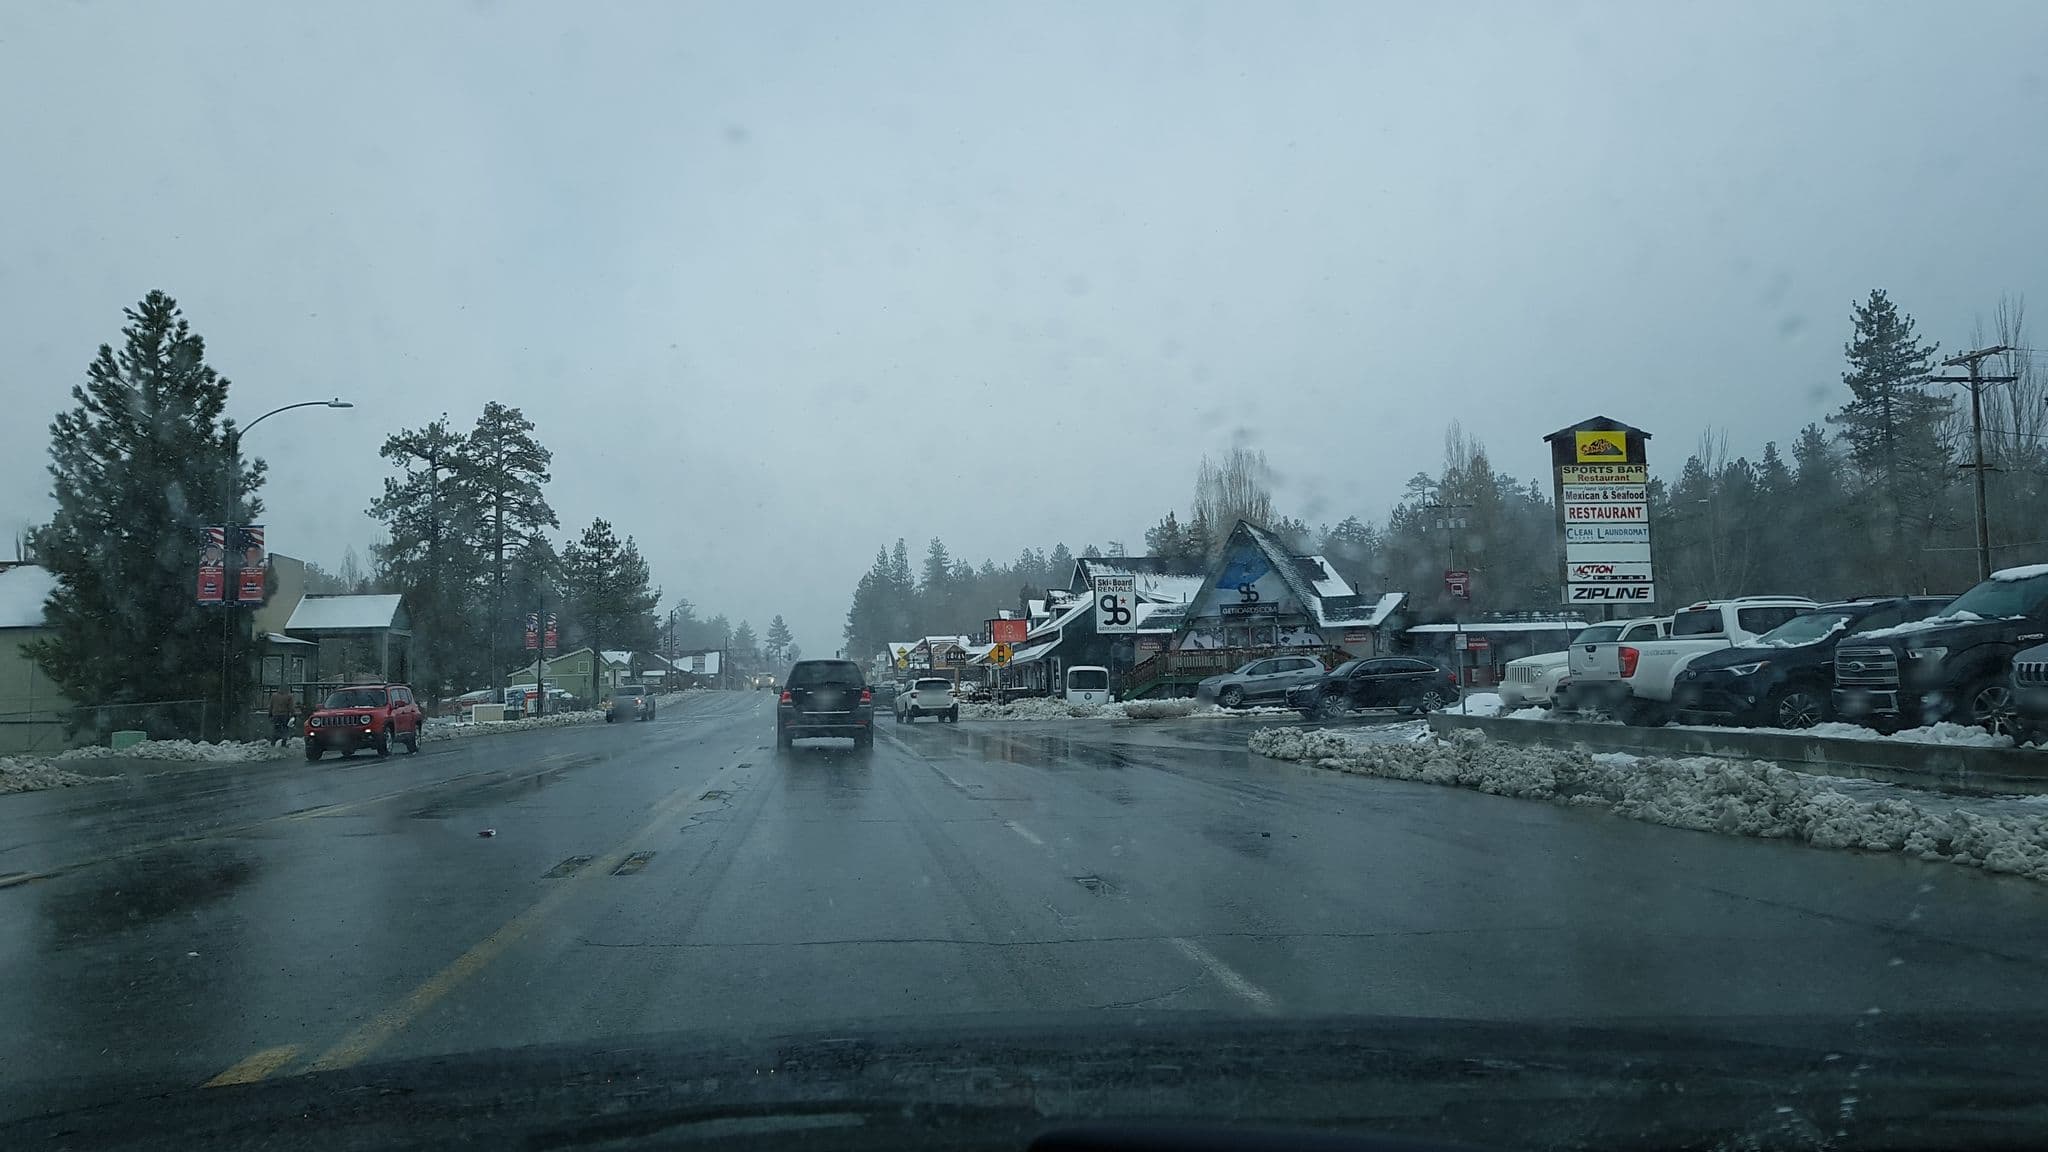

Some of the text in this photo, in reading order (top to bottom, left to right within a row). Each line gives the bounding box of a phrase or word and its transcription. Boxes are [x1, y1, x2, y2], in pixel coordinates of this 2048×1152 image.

[1565, 490, 1644, 500] Mexican & Seafood
[1569, 507, 1642, 519] RESTAURANT
[1576, 565, 1614, 574] ACTION
[1573, 587, 1649, 599] ZIPLINE
